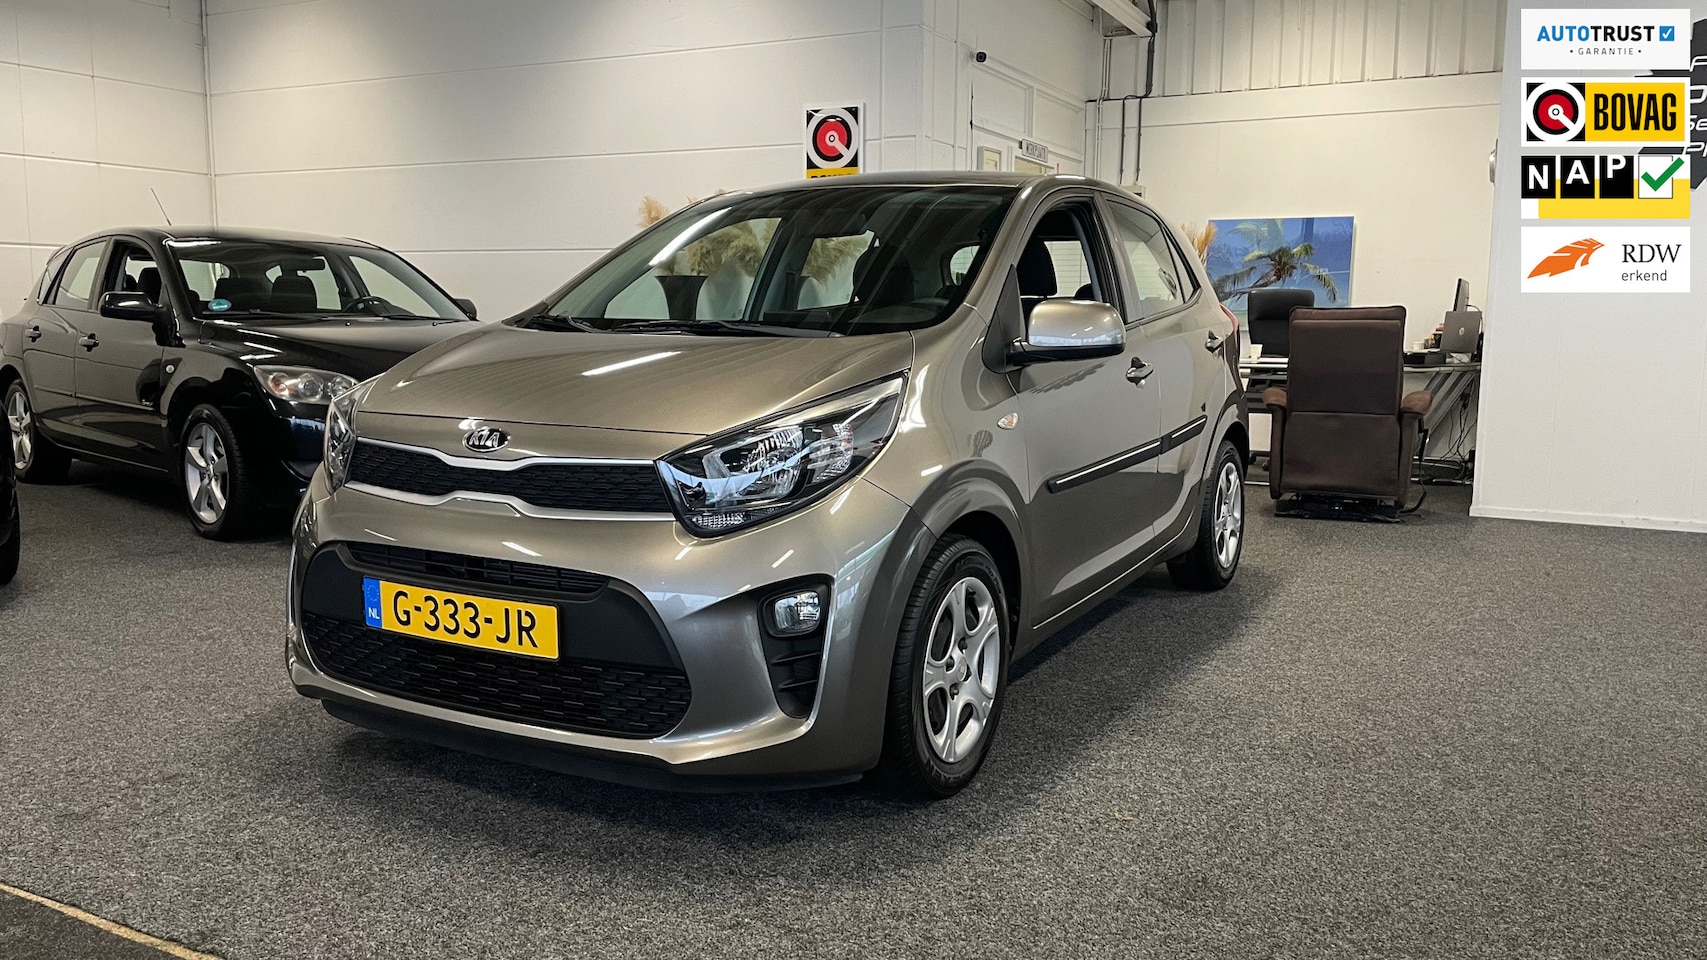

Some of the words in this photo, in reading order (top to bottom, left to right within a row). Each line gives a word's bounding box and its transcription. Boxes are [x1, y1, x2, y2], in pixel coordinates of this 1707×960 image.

[468, 430, 500, 448] KIA
[368, 606, 380, 620] NL
[393, 590, 538, 649] G-333-JR
